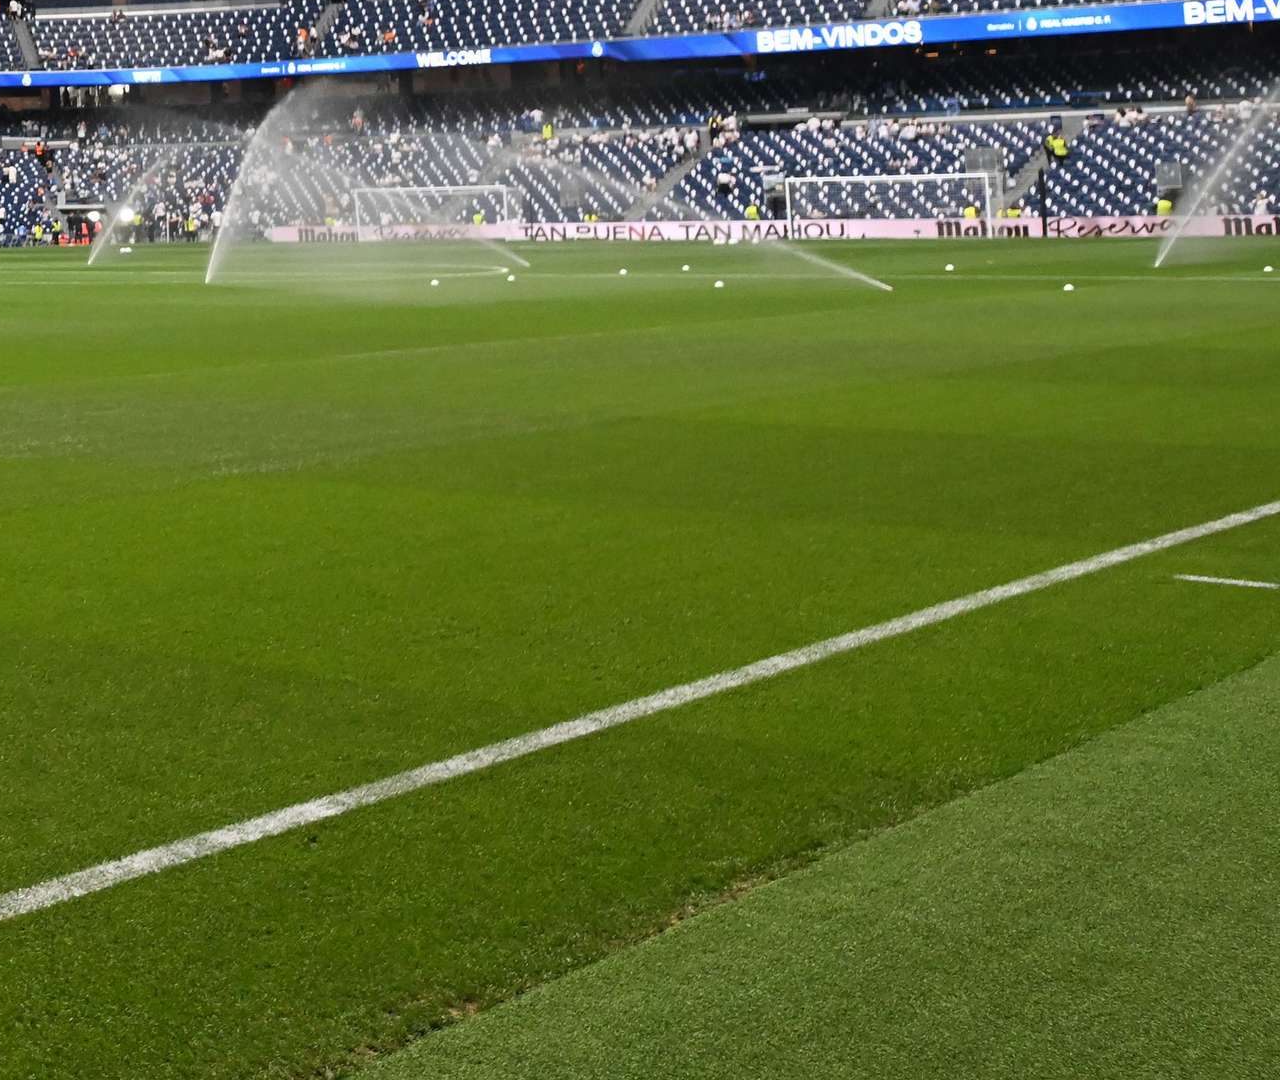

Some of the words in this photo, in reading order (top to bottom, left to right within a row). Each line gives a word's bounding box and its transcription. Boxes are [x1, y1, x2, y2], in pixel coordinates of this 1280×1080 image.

[756, 21, 923, 52] BEM-VINDOS
[416, 48, 492, 67] WELCOME
[519, 226, 567, 241] TAN
[678, 223, 732, 240] TAN
